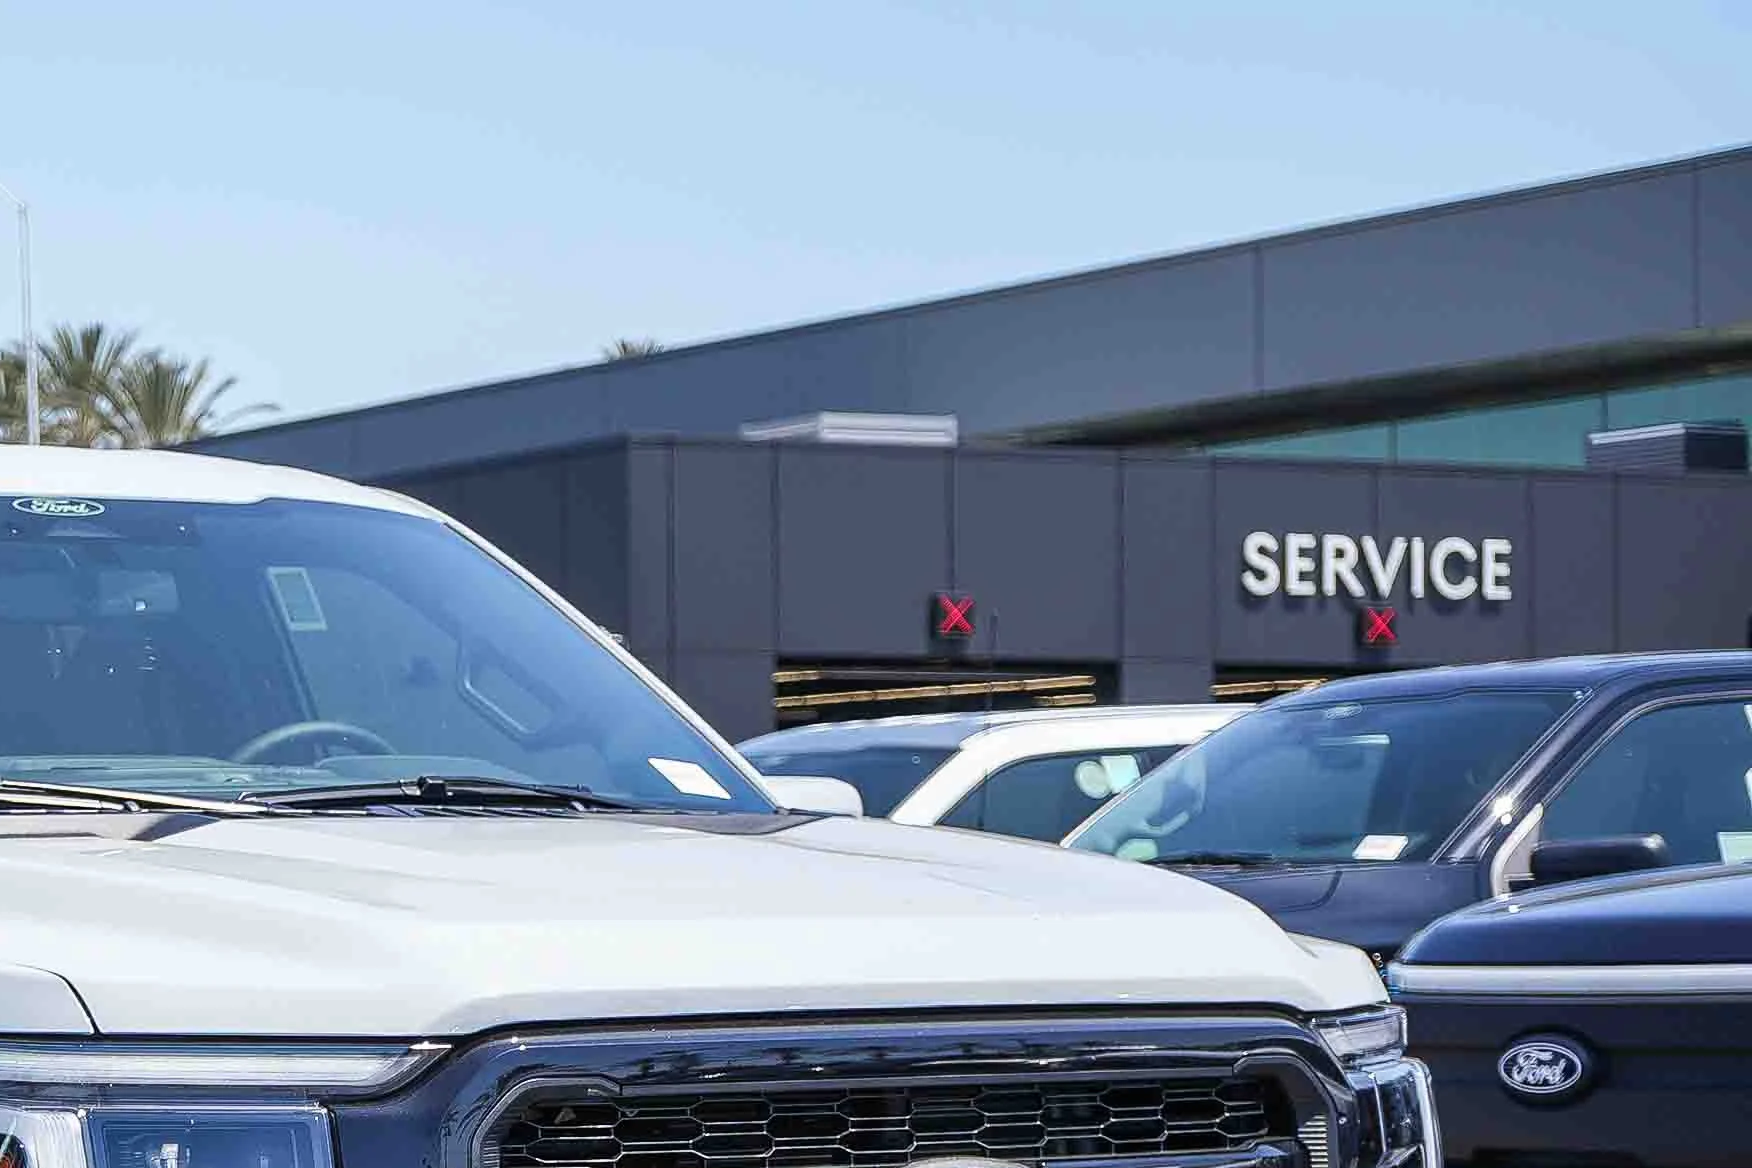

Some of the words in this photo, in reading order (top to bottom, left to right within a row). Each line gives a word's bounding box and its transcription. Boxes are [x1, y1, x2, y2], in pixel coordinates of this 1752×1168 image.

[31, 498, 89, 513] Ford
[1241, 531, 1512, 600] SERVICE
[1512, 1050, 1566, 1085] Ford
